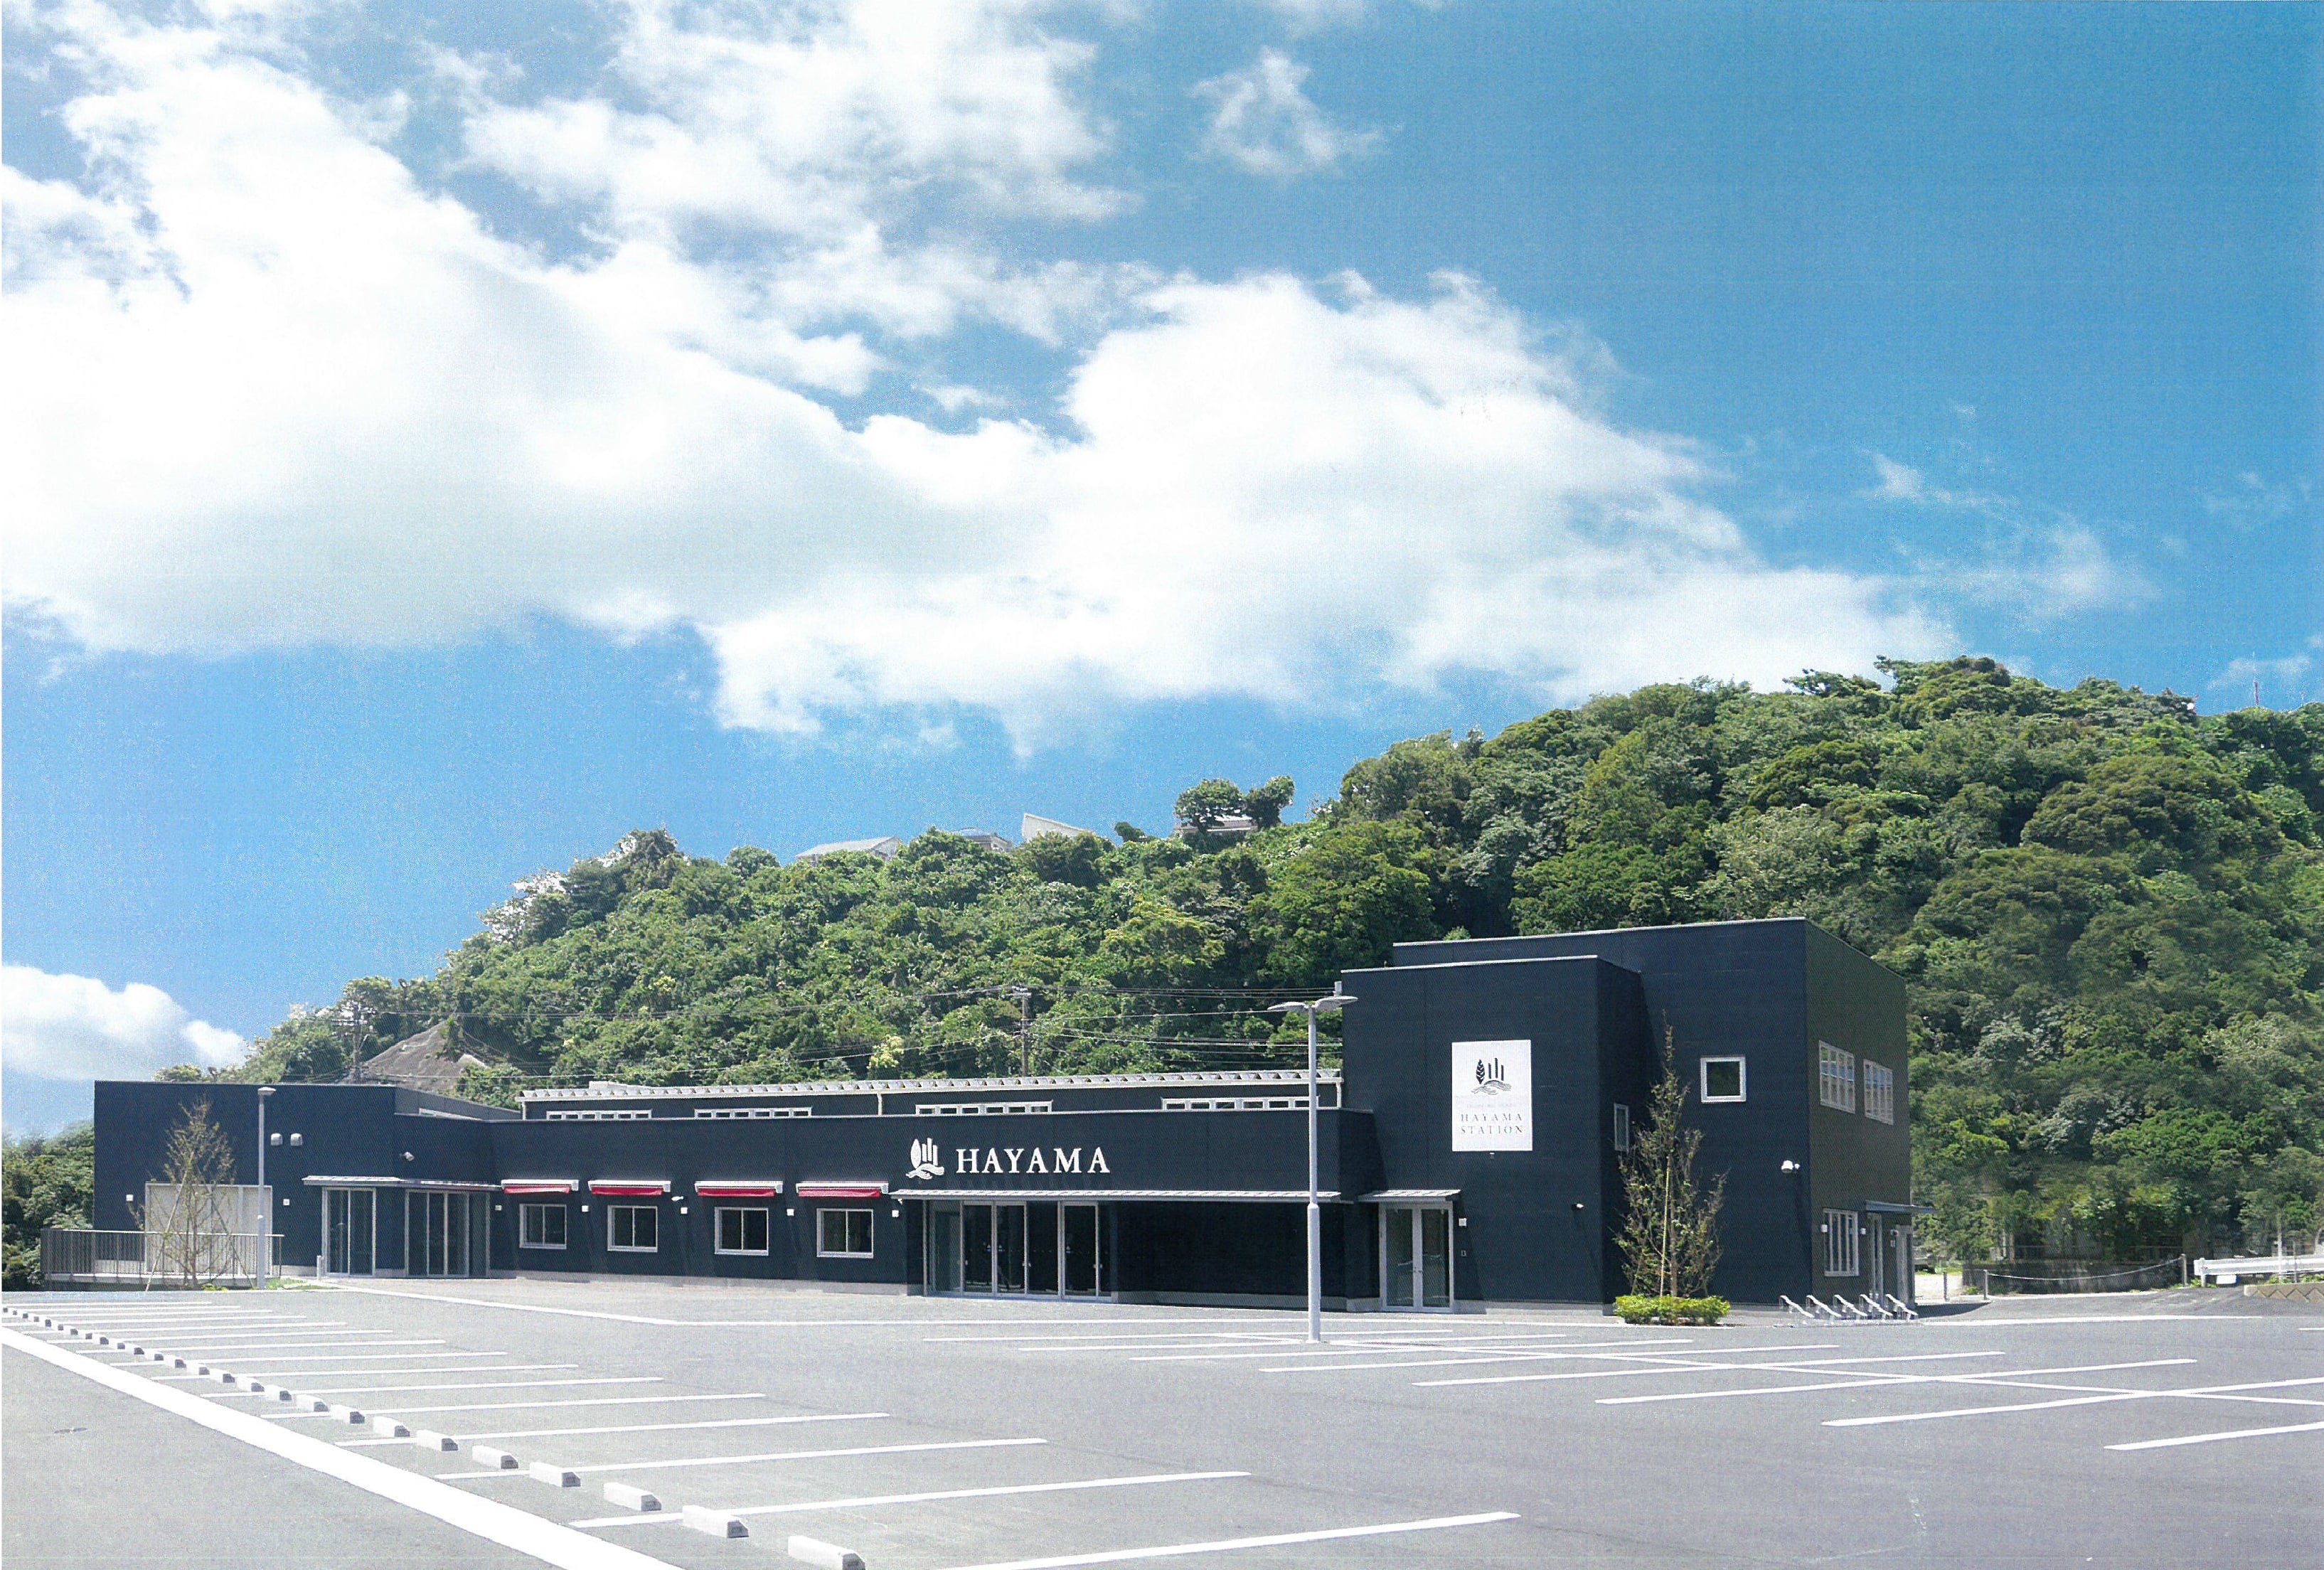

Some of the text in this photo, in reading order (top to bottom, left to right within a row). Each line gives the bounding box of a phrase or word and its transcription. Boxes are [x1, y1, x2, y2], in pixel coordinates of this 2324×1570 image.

[1461, 1113, 1523, 1121] HAYAMA
[1461, 1126, 1523, 1134] STATION
[956, 1147, 1110, 1173] HAYAMA
